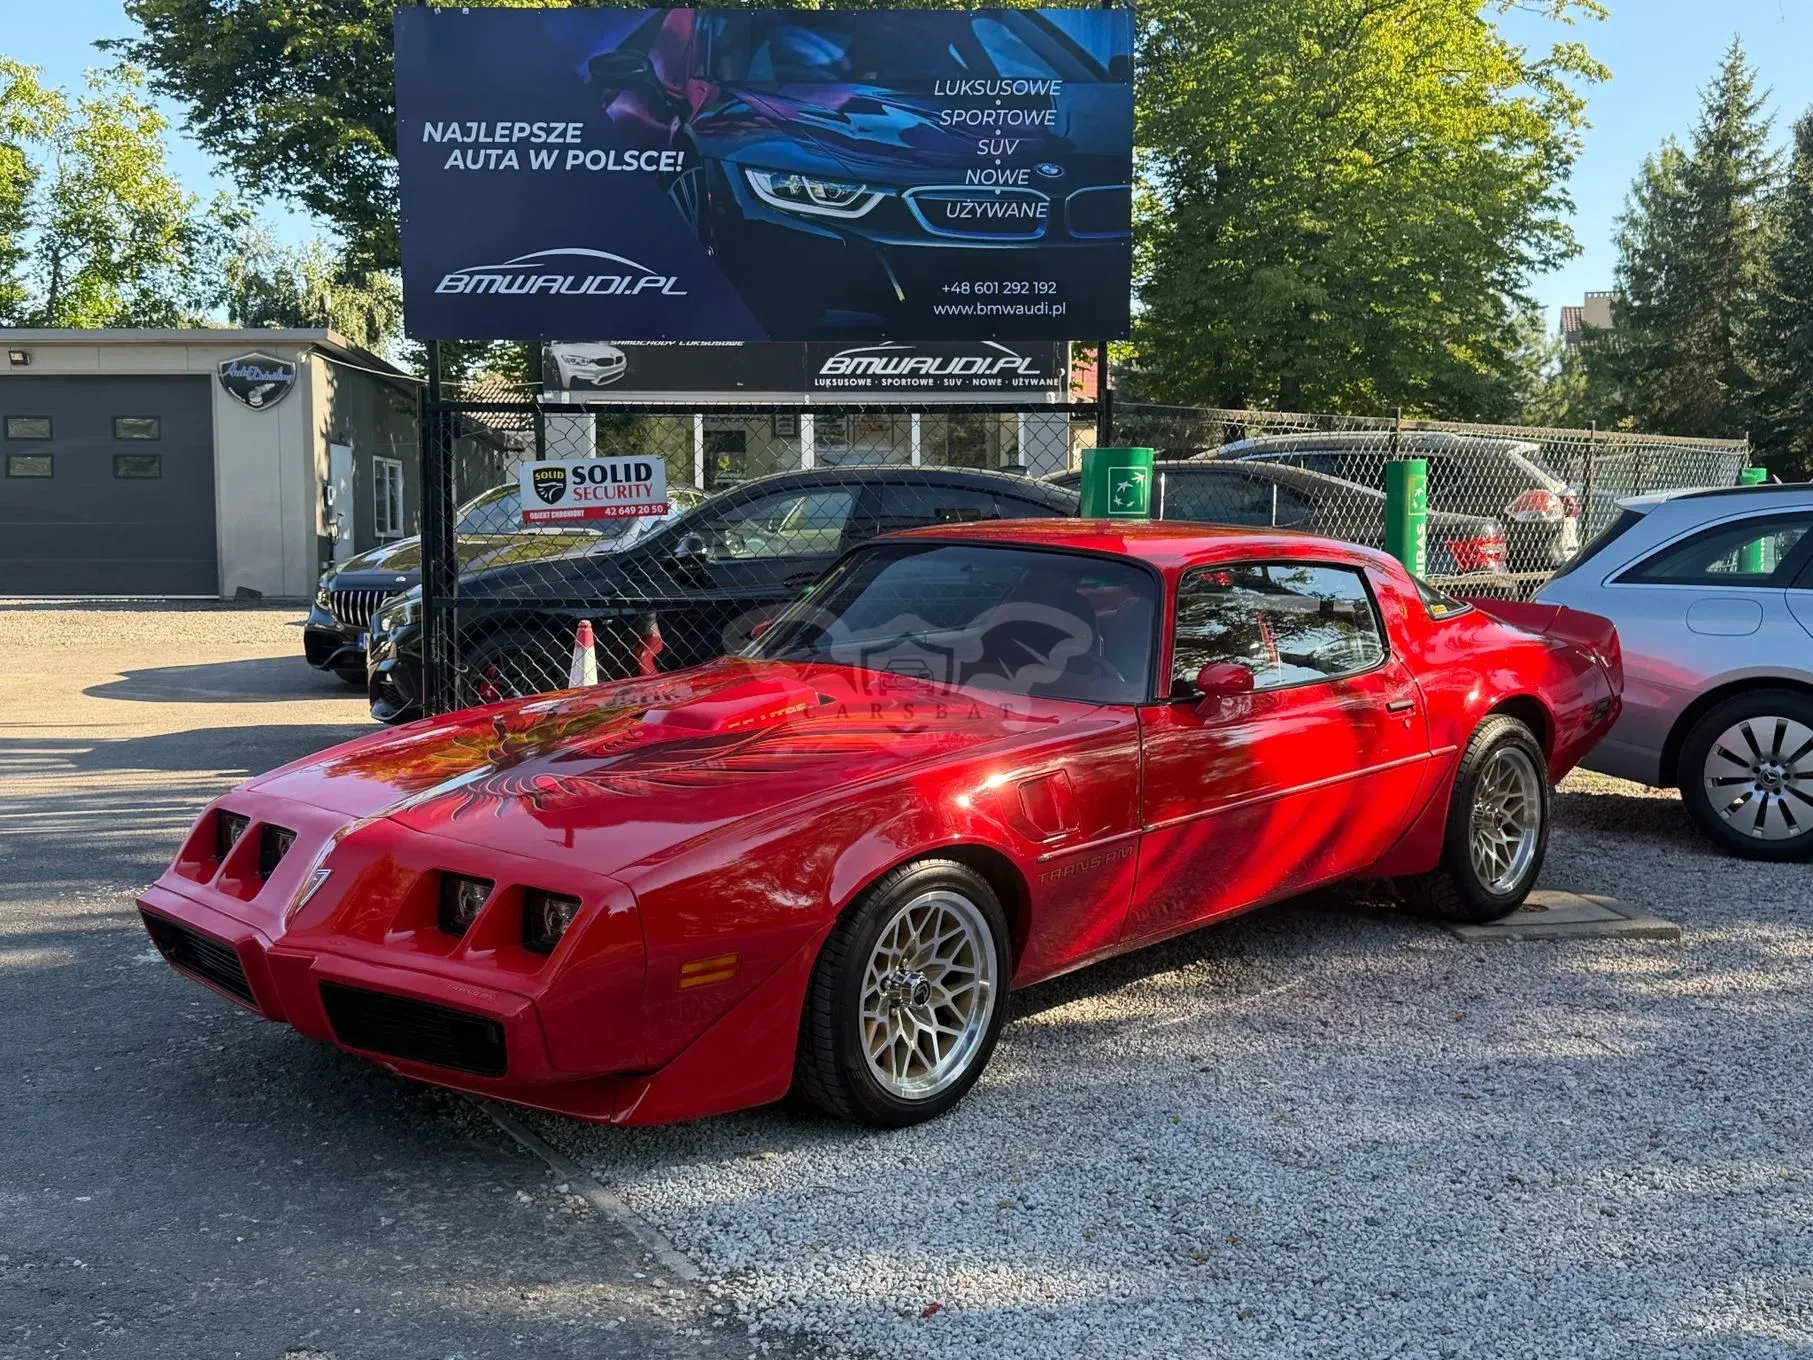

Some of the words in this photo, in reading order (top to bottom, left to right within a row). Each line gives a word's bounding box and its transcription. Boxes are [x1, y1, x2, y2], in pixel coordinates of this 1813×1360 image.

[934, 79, 1062, 96] LUKSUSOWE
[939, 109, 1057, 126] SPORTOWE
[422, 121, 584, 144] NAJLEPSZE
[976, 139, 1020, 155] SUV
[444, 149, 520, 171] AUTA
[529, 150, 560, 171] W
[565, 150, 685, 172] POLSCE!
[965, 169, 1031, 185] NOWE
[946, 199, 1049, 218] UŻYWANE
[434, 273, 688, 296] BMWAUDI.PL
[942, 281, 970, 295] +48
[974, 281, 999, 294] 601
[1003, 282, 1030, 295] 292
[1033, 282, 1057, 295] 192
[933, 302, 1066, 317] www.bmwaudi.pl
[819, 356, 1041, 375] BMWAUDI.PL
[814, 377, 872, 387] LUKSUSOWE
[881, 377, 934, 387] SPORTOWE
[943, 377, 963, 387] SUV
[972, 377, 1002, 387] NOWE
[1012, 376, 1060, 387] UŻYWANE
[534, 470, 565, 481] SOLID
[571, 462, 653, 486] SOLID
[573, 483, 654, 502] SECURITY
[604, 507, 617, 517] 42
[618, 506, 636, 516] 649
[638, 505, 651, 515] 20
[1038, 856, 1101, 884] TRANS
[1105, 846, 1134, 864] AM
